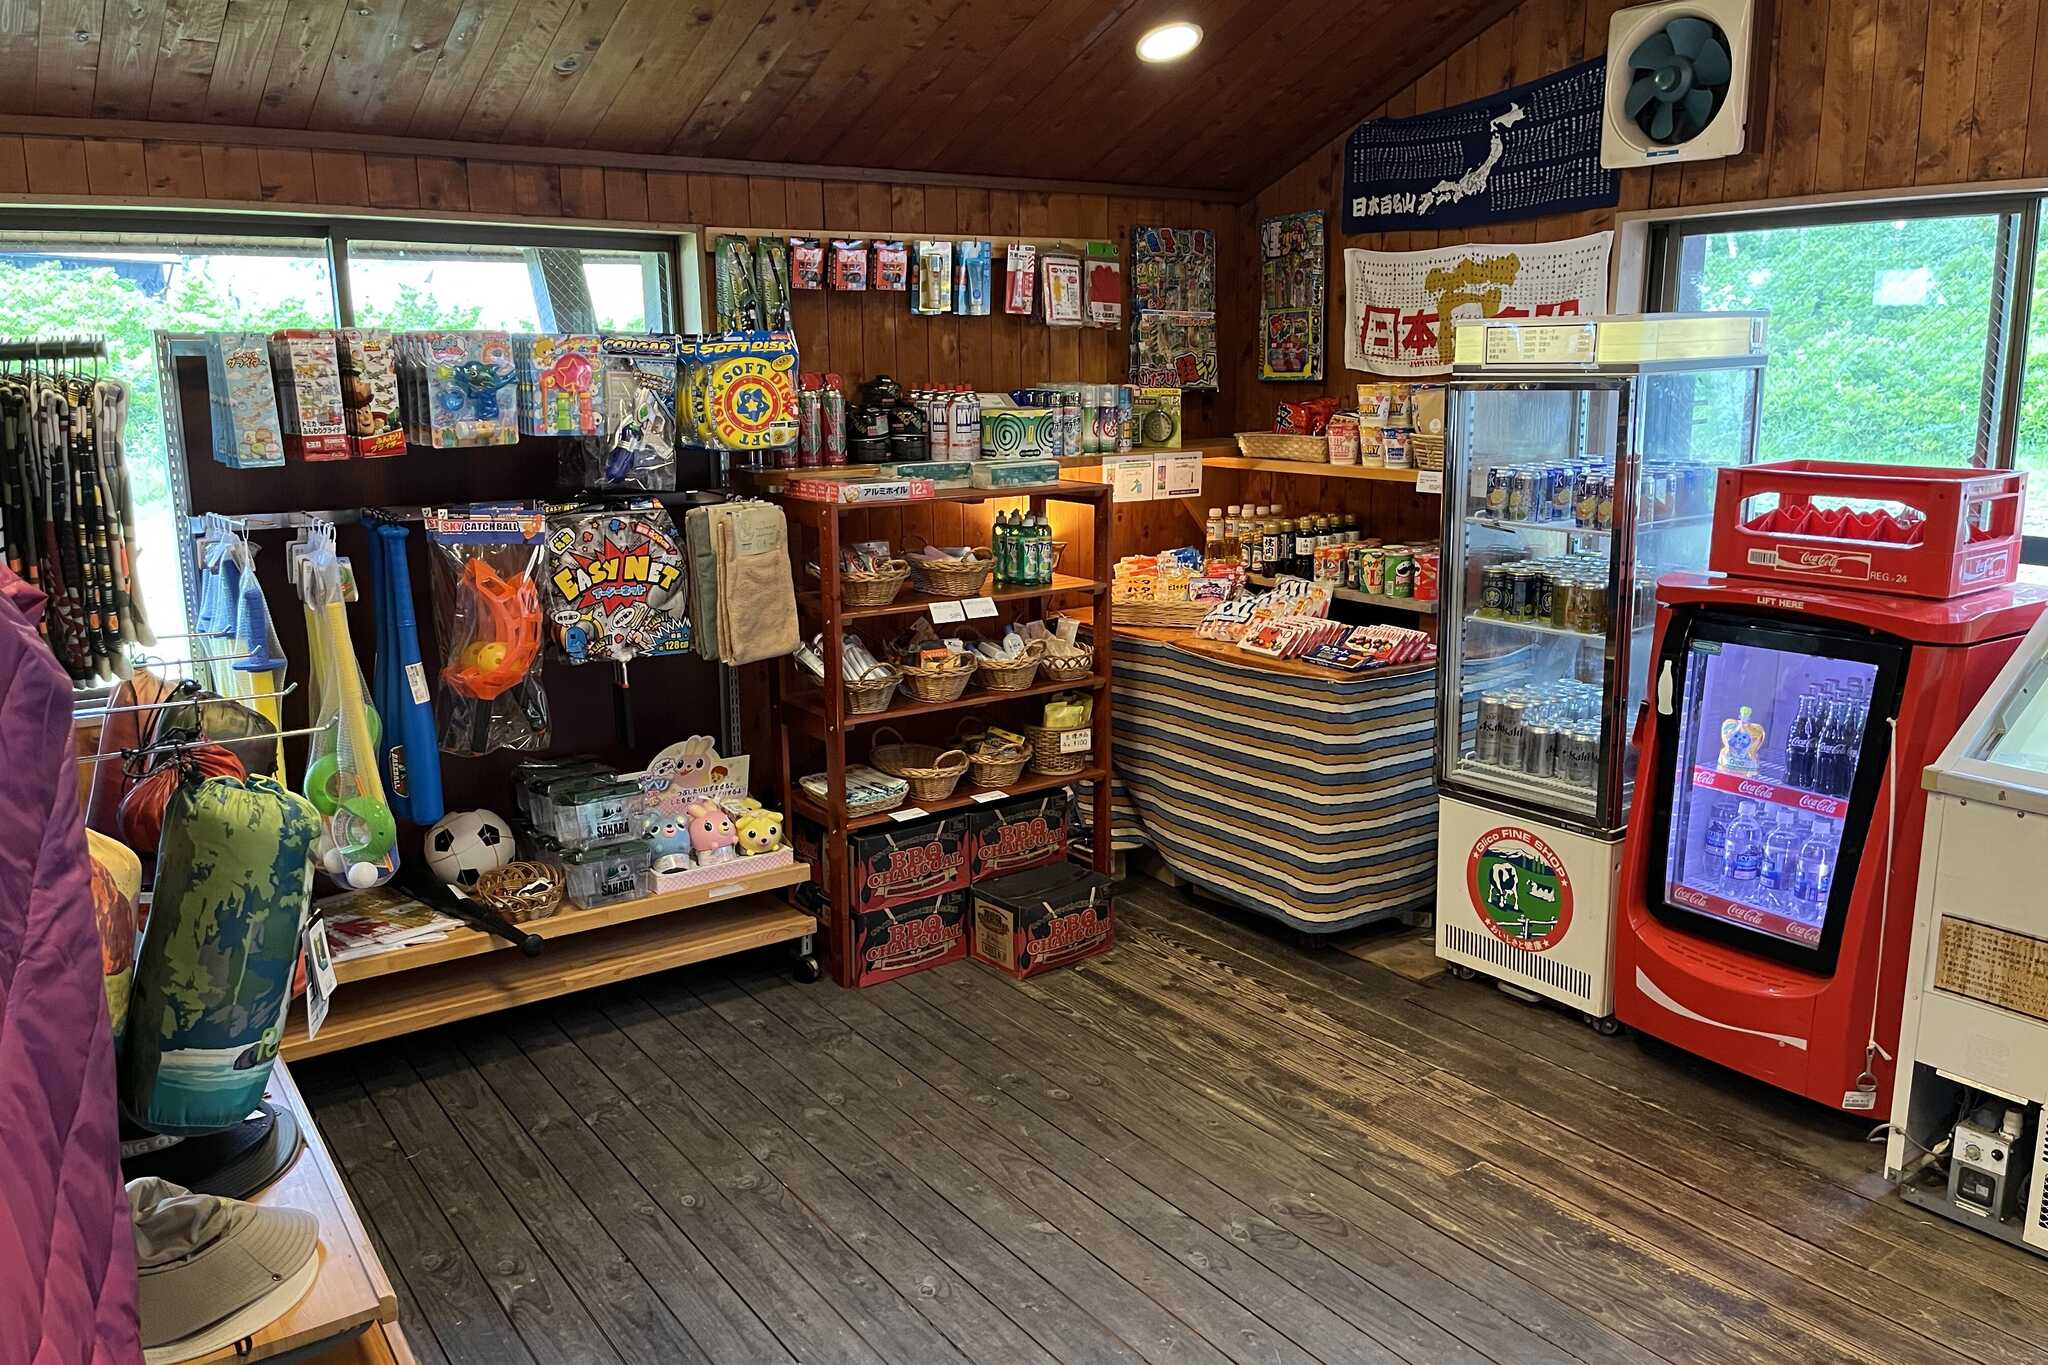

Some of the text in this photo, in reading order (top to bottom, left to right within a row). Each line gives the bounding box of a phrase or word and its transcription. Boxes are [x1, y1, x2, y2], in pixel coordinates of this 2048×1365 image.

[1352, 192, 1417, 217] 日本百名山
[699, 342, 747, 354] SOFT
[751, 340, 794, 352] DISK
[722, 362, 767, 384] SOFT
[863, 486, 908, 497] アルミホイル
[442, 522, 463, 532] SKY
[464, 521, 519, 532] CATCHBALL
[1800, 552, 1839, 568] Coca-Cola
[553, 555, 681, 602] EASY NET
[1870, 571, 1907, 583] REG 24
[1757, 595, 1804, 610] LIFT HERE
[1738, 780, 1774, 799] Coca-Cola
[1800, 794, 1837, 814] Coca-Cola
[596, 822, 630, 838] SAHARA
[998, 817, 1049, 845] BBQ
[889, 841, 943, 868] BBQ
[978, 828, 1065, 861] CHARCOAL
[1476, 829, 1566, 877] Glico FINE SHOP
[867, 851, 964, 889] CHARCOAL
[601, 880, 635, 896] SAHARA
[1674, 886, 1707, 908] Coca-Cola
[1049, 908, 1098, 936] BBQ
[1727, 903, 1763, 925] Coca-Cola
[889, 914, 943, 941] BBQ
[1027, 916, 1113, 956] CHARCOAL
[866, 922, 963, 962] CHARCOAL
